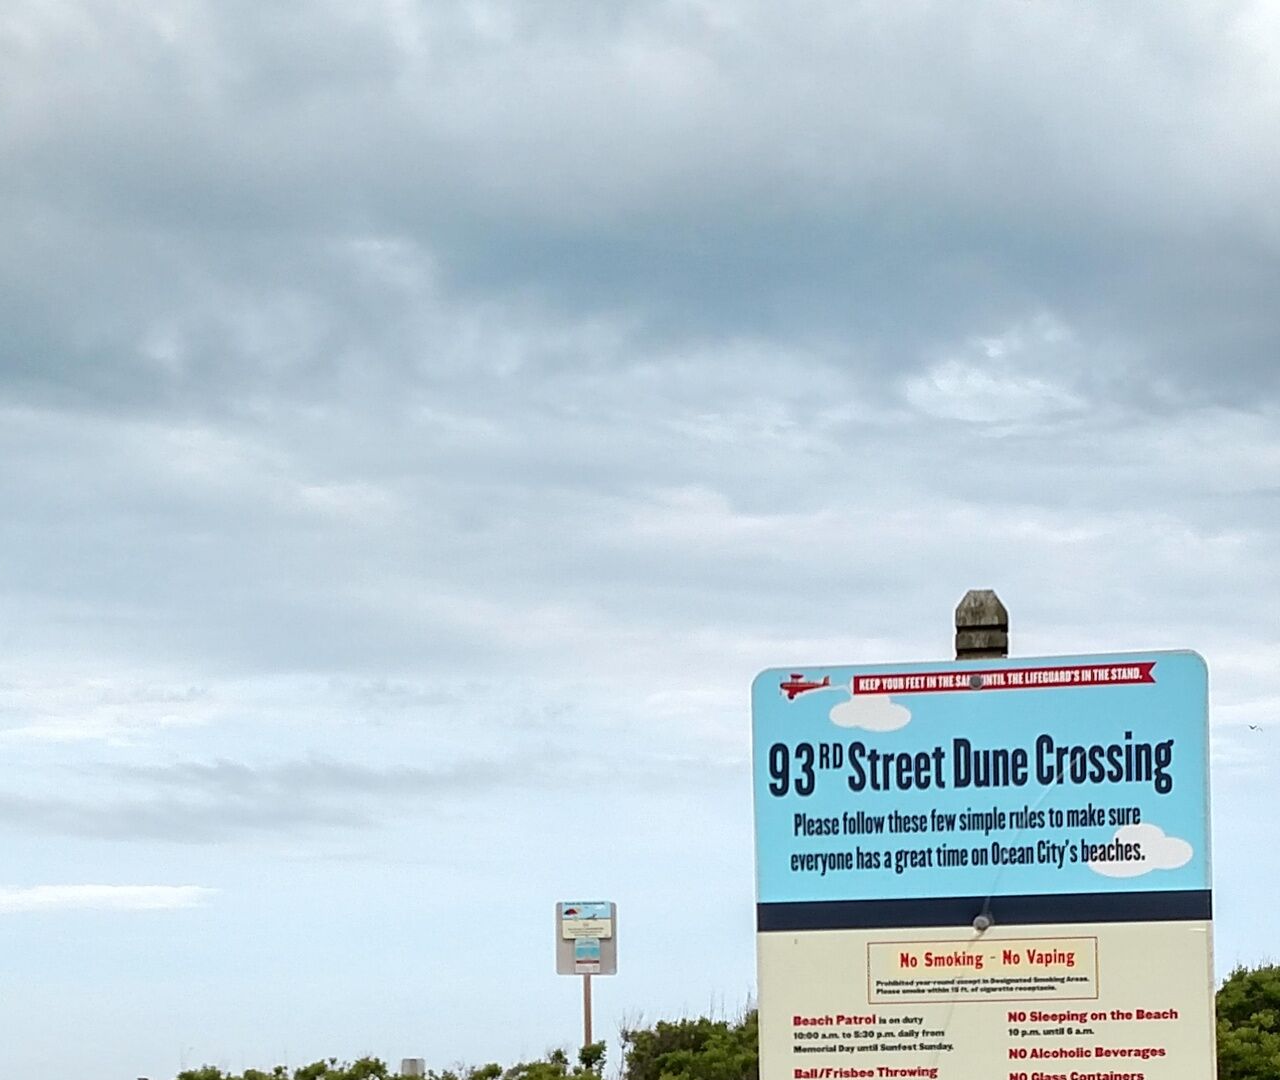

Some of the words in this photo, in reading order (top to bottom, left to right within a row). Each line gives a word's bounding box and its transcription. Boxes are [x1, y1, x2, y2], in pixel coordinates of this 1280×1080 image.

[859, 678, 880, 691] KEEP
[882, 677, 904, 690] YOUR
[905, 676, 925, 689] FEET
[926, 676, 937, 688] IN
[938, 675, 954, 688] THE
[1007, 672, 1024, 685] THE
[1025, 670, 1080, 685] LIFEGUARD'S
[1081, 669, 1092, 682] IN
[1093, 668, 1110, 681] THE
[1111, 667, 1143, 680] STAND.
[769, 742, 844, 797] 93RD
[848, 741, 946, 792] Street
[953, 738, 1028, 788] Dune
[1036, 731, 1174, 795] Crossing
[794, 813, 839, 836] Please
[843, 811, 885, 835] follow
[888, 810, 927, 833] these
[930, 809, 956, 832] few
[959, 806, 1006, 836] simple
[1009, 805, 1045, 829] rules
[1049, 808, 1063, 828] to
[1067, 803, 1105, 827] make
[1109, 807, 1141, 826] sure
[790, 851, 853, 876] everyone
[856, 846, 880, 870] has
[883, 853, 892, 869] a
[895, 848, 933, 874] great
[936, 843, 968, 867] time
[971, 848, 989, 866] on
[991, 842, 1034, 865] Ocean
[1037, 839, 1078, 869] City's
[1081, 838, 1146, 862] beaches.
[900, 952, 917, 968] No
[924, 951, 983, 969] Smoking
[1002, 949, 1020, 965] No
[1026, 949, 1075, 967] Vaping
[1034, 976, 1065, 984] Smoking
[793, 1015, 833, 1026] Beach
[836, 1014, 876, 1025] Patrol
[879, 1016, 887, 1024] is
[902, 1016, 923, 1026] duty
[1008, 1012, 1027, 1022] NO
[1029, 1010, 1087, 1024] Sleeping
[1090, 1012, 1107, 1021] on
[1110, 1010, 1133, 1020] the
[1135, 1009, 1178, 1020] Beach
[793, 1031, 819, 1040] 10:00
[842, 1031, 851, 1039] to
[854, 1030, 875, 1038] 5:30
[876, 1031, 896, 1039] p.m.
[898, 1029, 919, 1039] daily
[922, 1029, 945, 1037] from
[1008, 1027, 1019, 1036] 10
[1021, 1028, 1041, 1037] p.m.
[1043, 1026, 1064, 1035] until
[1066, 1026, 1073, 1035] 6
[793, 1045, 836, 1053] Memorial
[838, 1044, 855, 1054] Day
[857, 1043, 878, 1052] until
[880, 1043, 917, 1051] Sunfest
[919, 1042, 954, 1052] Sunday.
[1009, 1048, 1027, 1059] NO
[1030, 1047, 1091, 1059] Alcoholic
[1094, 1046, 1166, 1060] Beverages
[794, 1067, 875, 1079] Ball/Frisbee
[877, 1066, 938, 1079] Throwing
